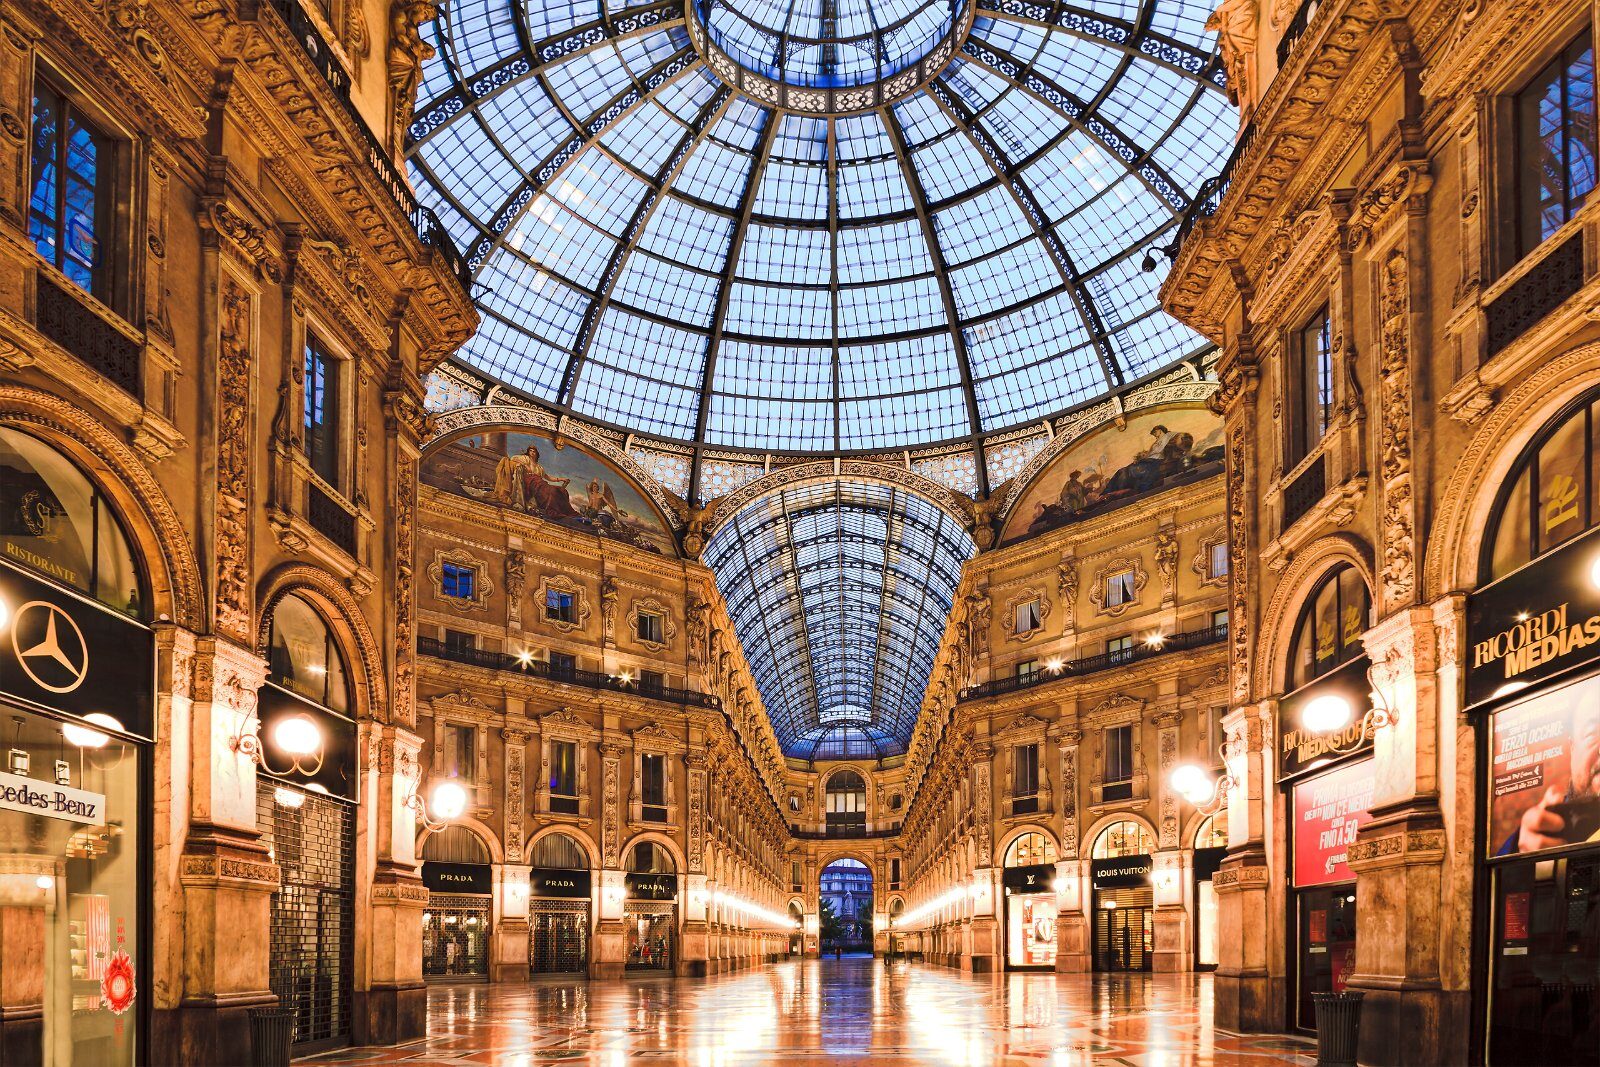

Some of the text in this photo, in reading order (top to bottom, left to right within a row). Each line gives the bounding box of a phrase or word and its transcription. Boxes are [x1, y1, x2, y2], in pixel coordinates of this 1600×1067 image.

[6, 542, 77, 583] RISTORANTE
[1473, 602, 1569, 669] RICORDI
[1505, 615, 1600, 679] MEDIAS
[1501, 732, 1527, 754] TERZO
[1322, 803, 1338, 822] NON
[1319, 818, 1359, 850] FINO A 50
[440, 874, 473, 882] PRADA
[545, 879, 575, 887] PRADA
[1097, 866, 1151, 878] LOUIS VUITTON
